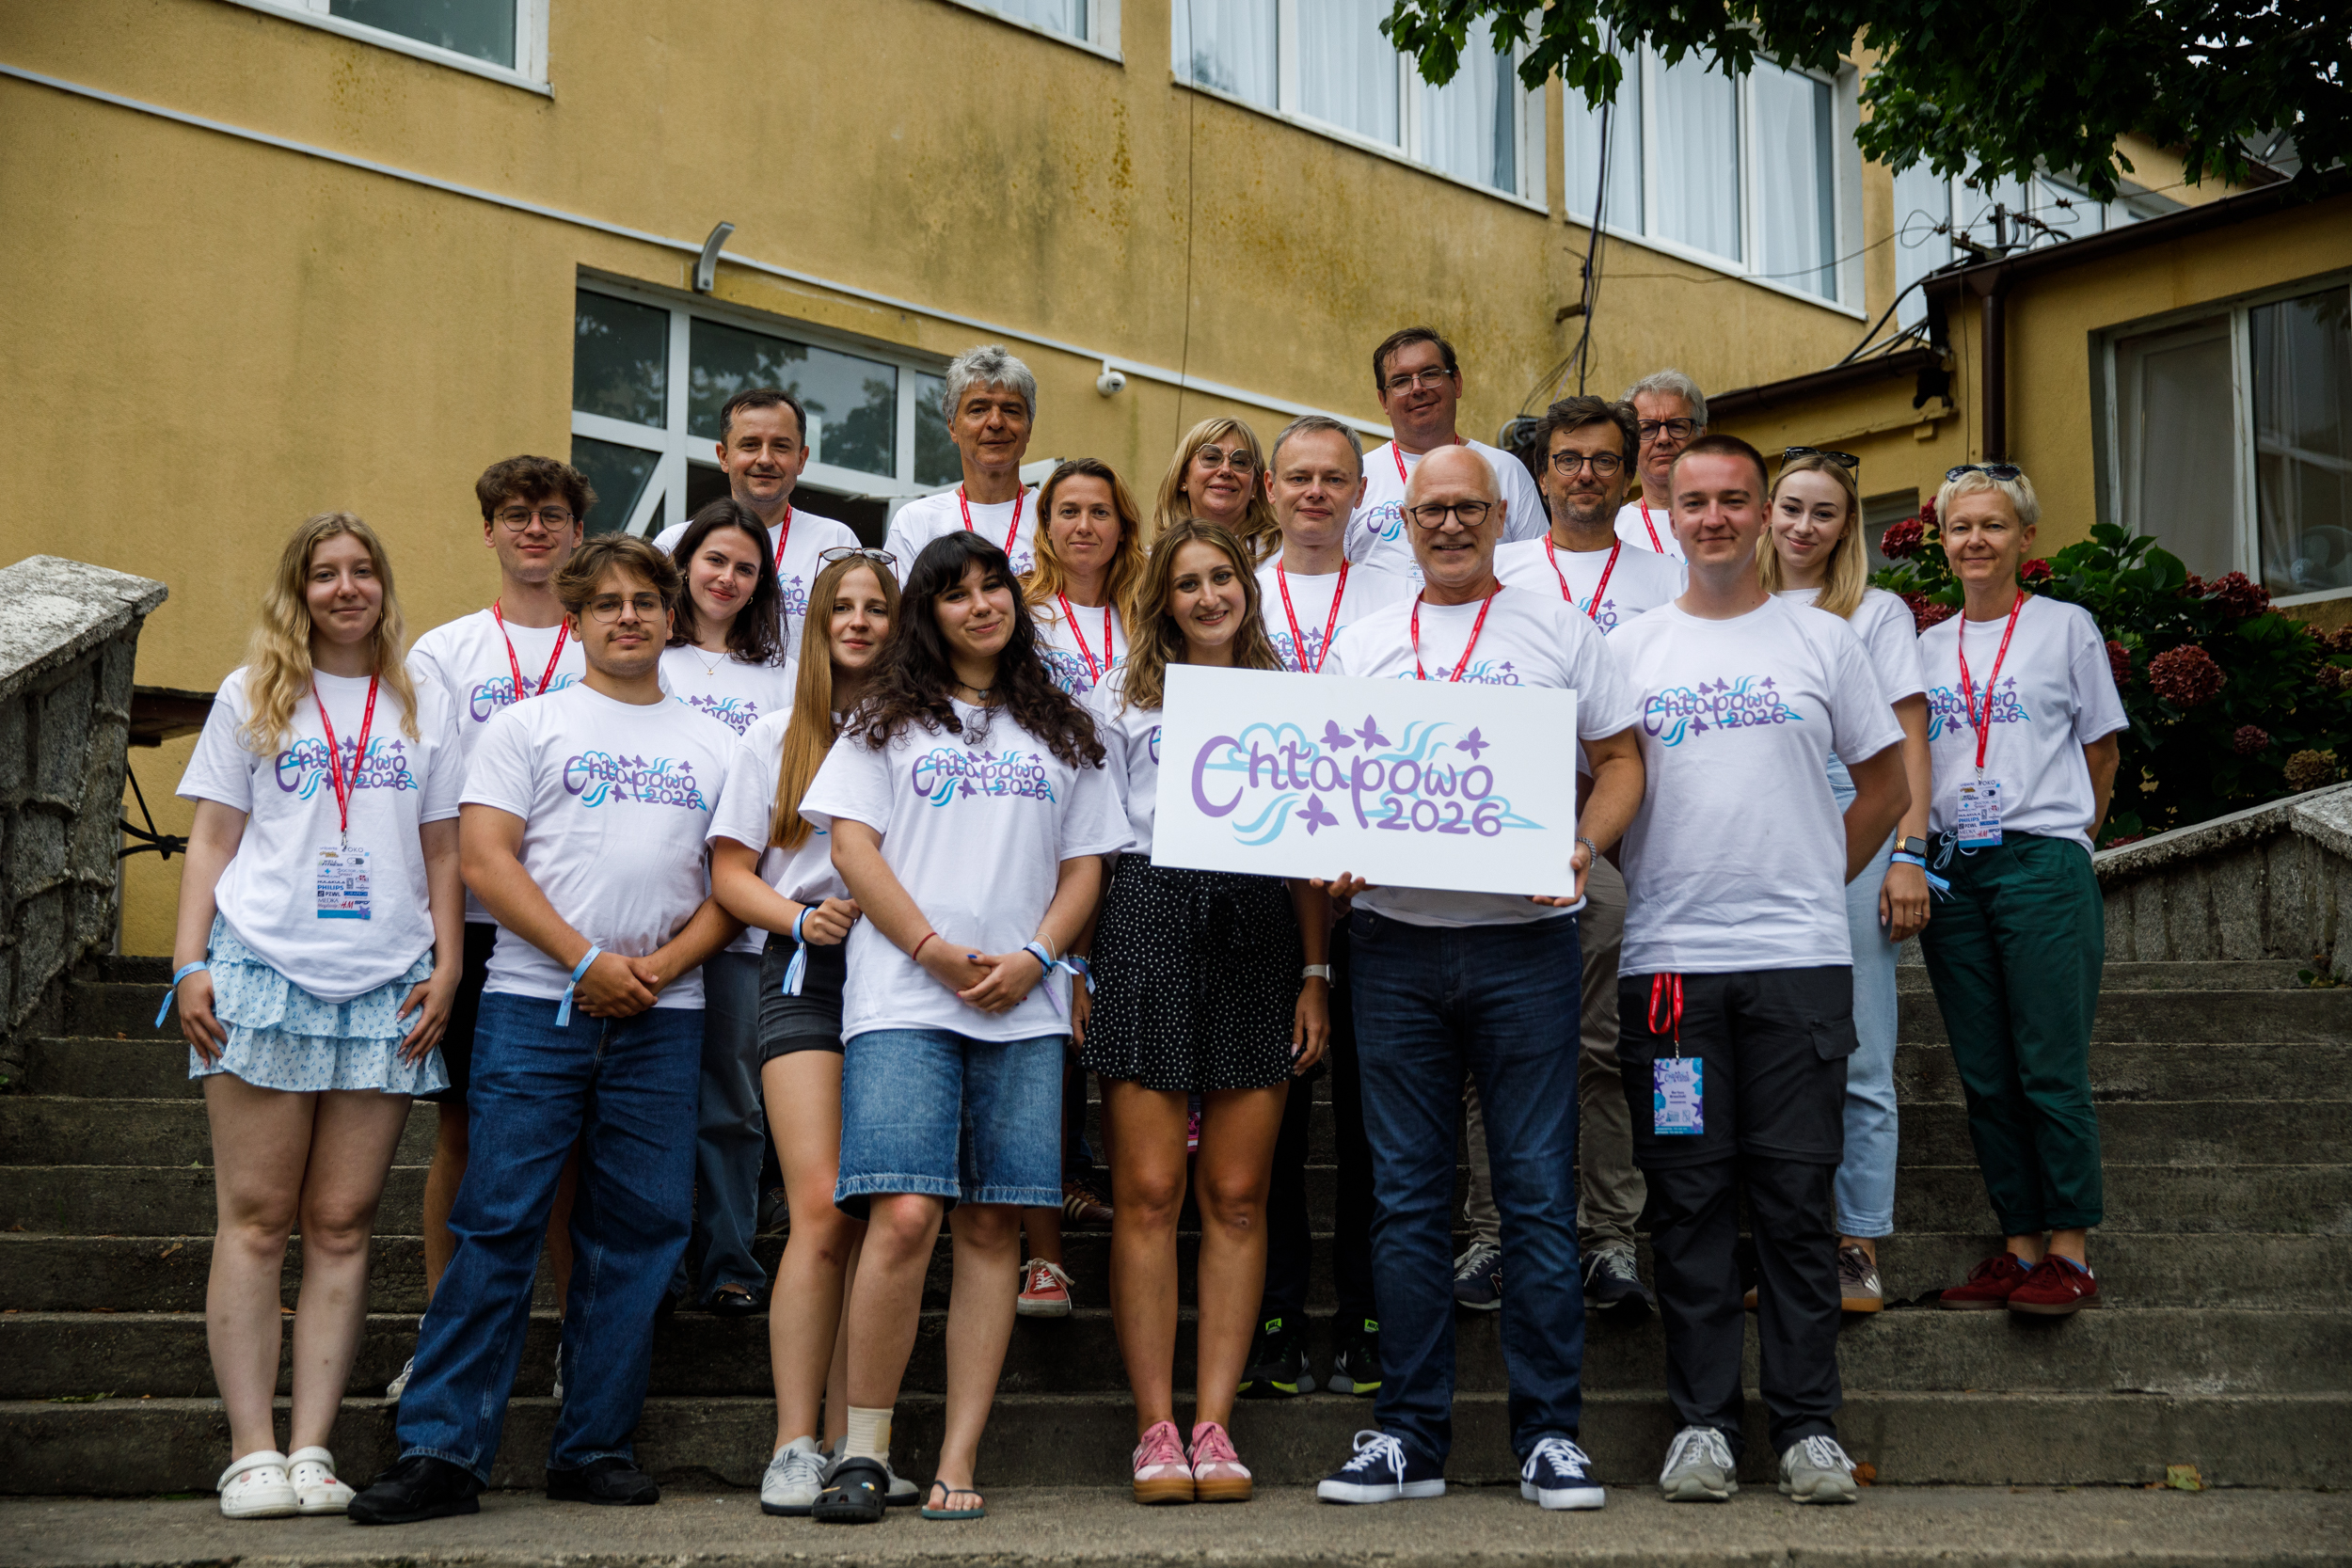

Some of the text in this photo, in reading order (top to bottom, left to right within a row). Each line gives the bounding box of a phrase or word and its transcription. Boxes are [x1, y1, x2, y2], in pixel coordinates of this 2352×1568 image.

[1726, 706, 1787, 728] 2026
[355, 771, 408, 791] 2026
[994, 779, 1047, 800] 2026
[644, 788, 699, 810] 2026
[1376, 797, 1502, 836] 2026
